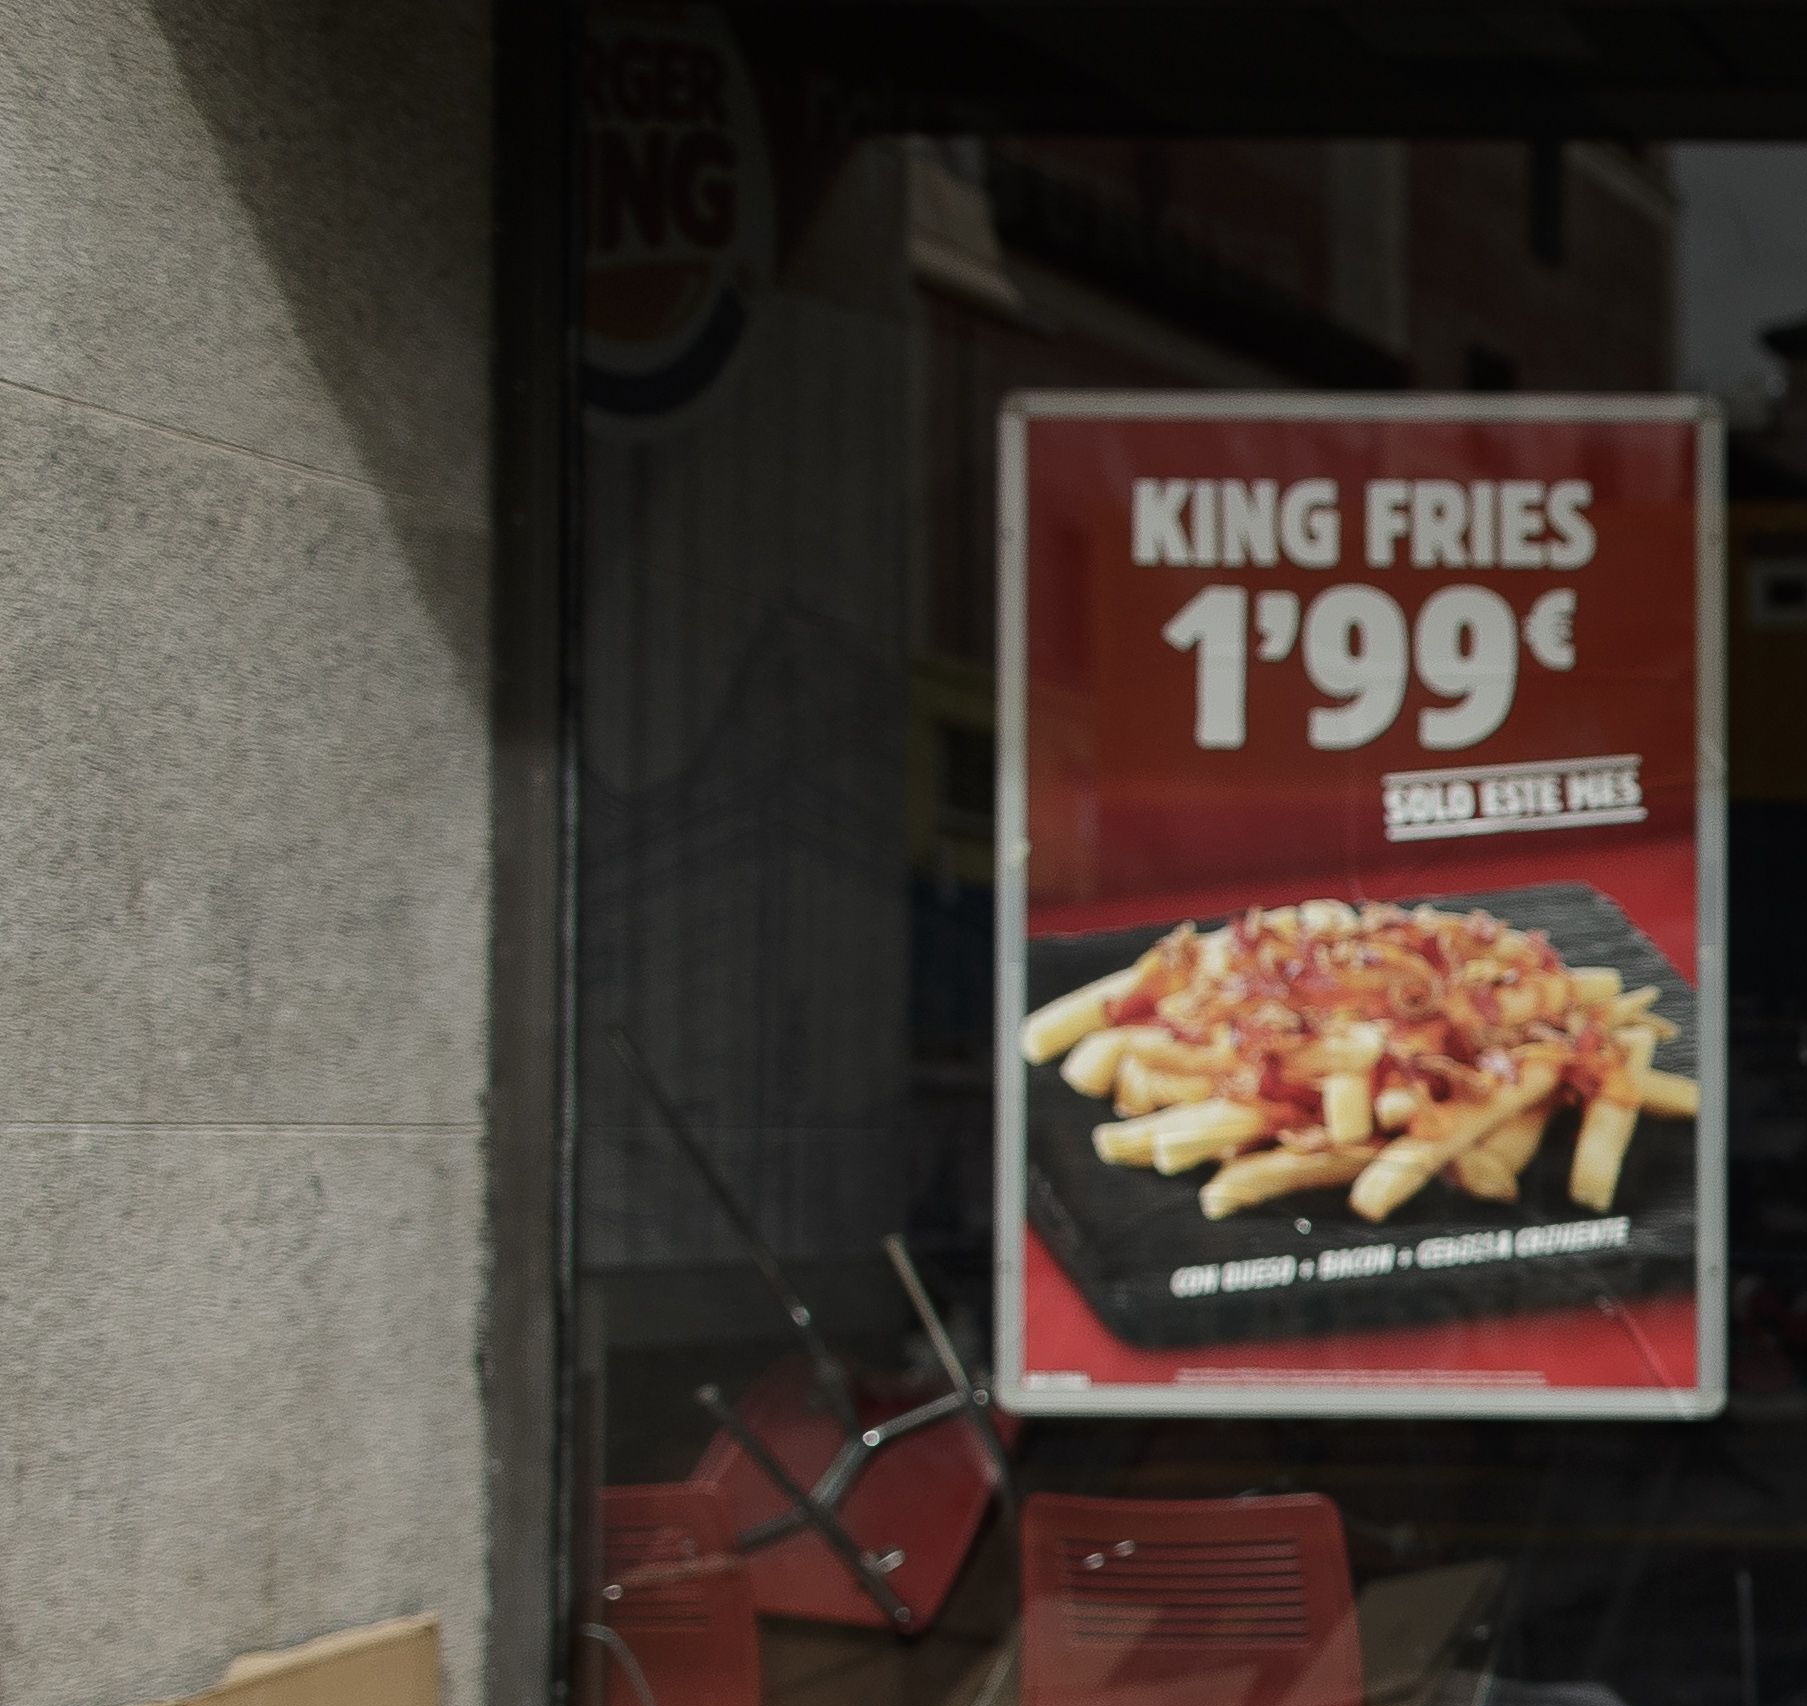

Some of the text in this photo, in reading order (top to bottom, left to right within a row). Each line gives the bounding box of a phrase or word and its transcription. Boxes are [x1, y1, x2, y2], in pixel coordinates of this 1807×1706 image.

[1132, 477, 1597, 571] KING FRIES
[1481, 775, 1566, 818] ESTE
[1566, 770, 1643, 810] MES
[1170, 1264, 1220, 1298] CON
[1317, 1243, 1396, 1281] BACON
